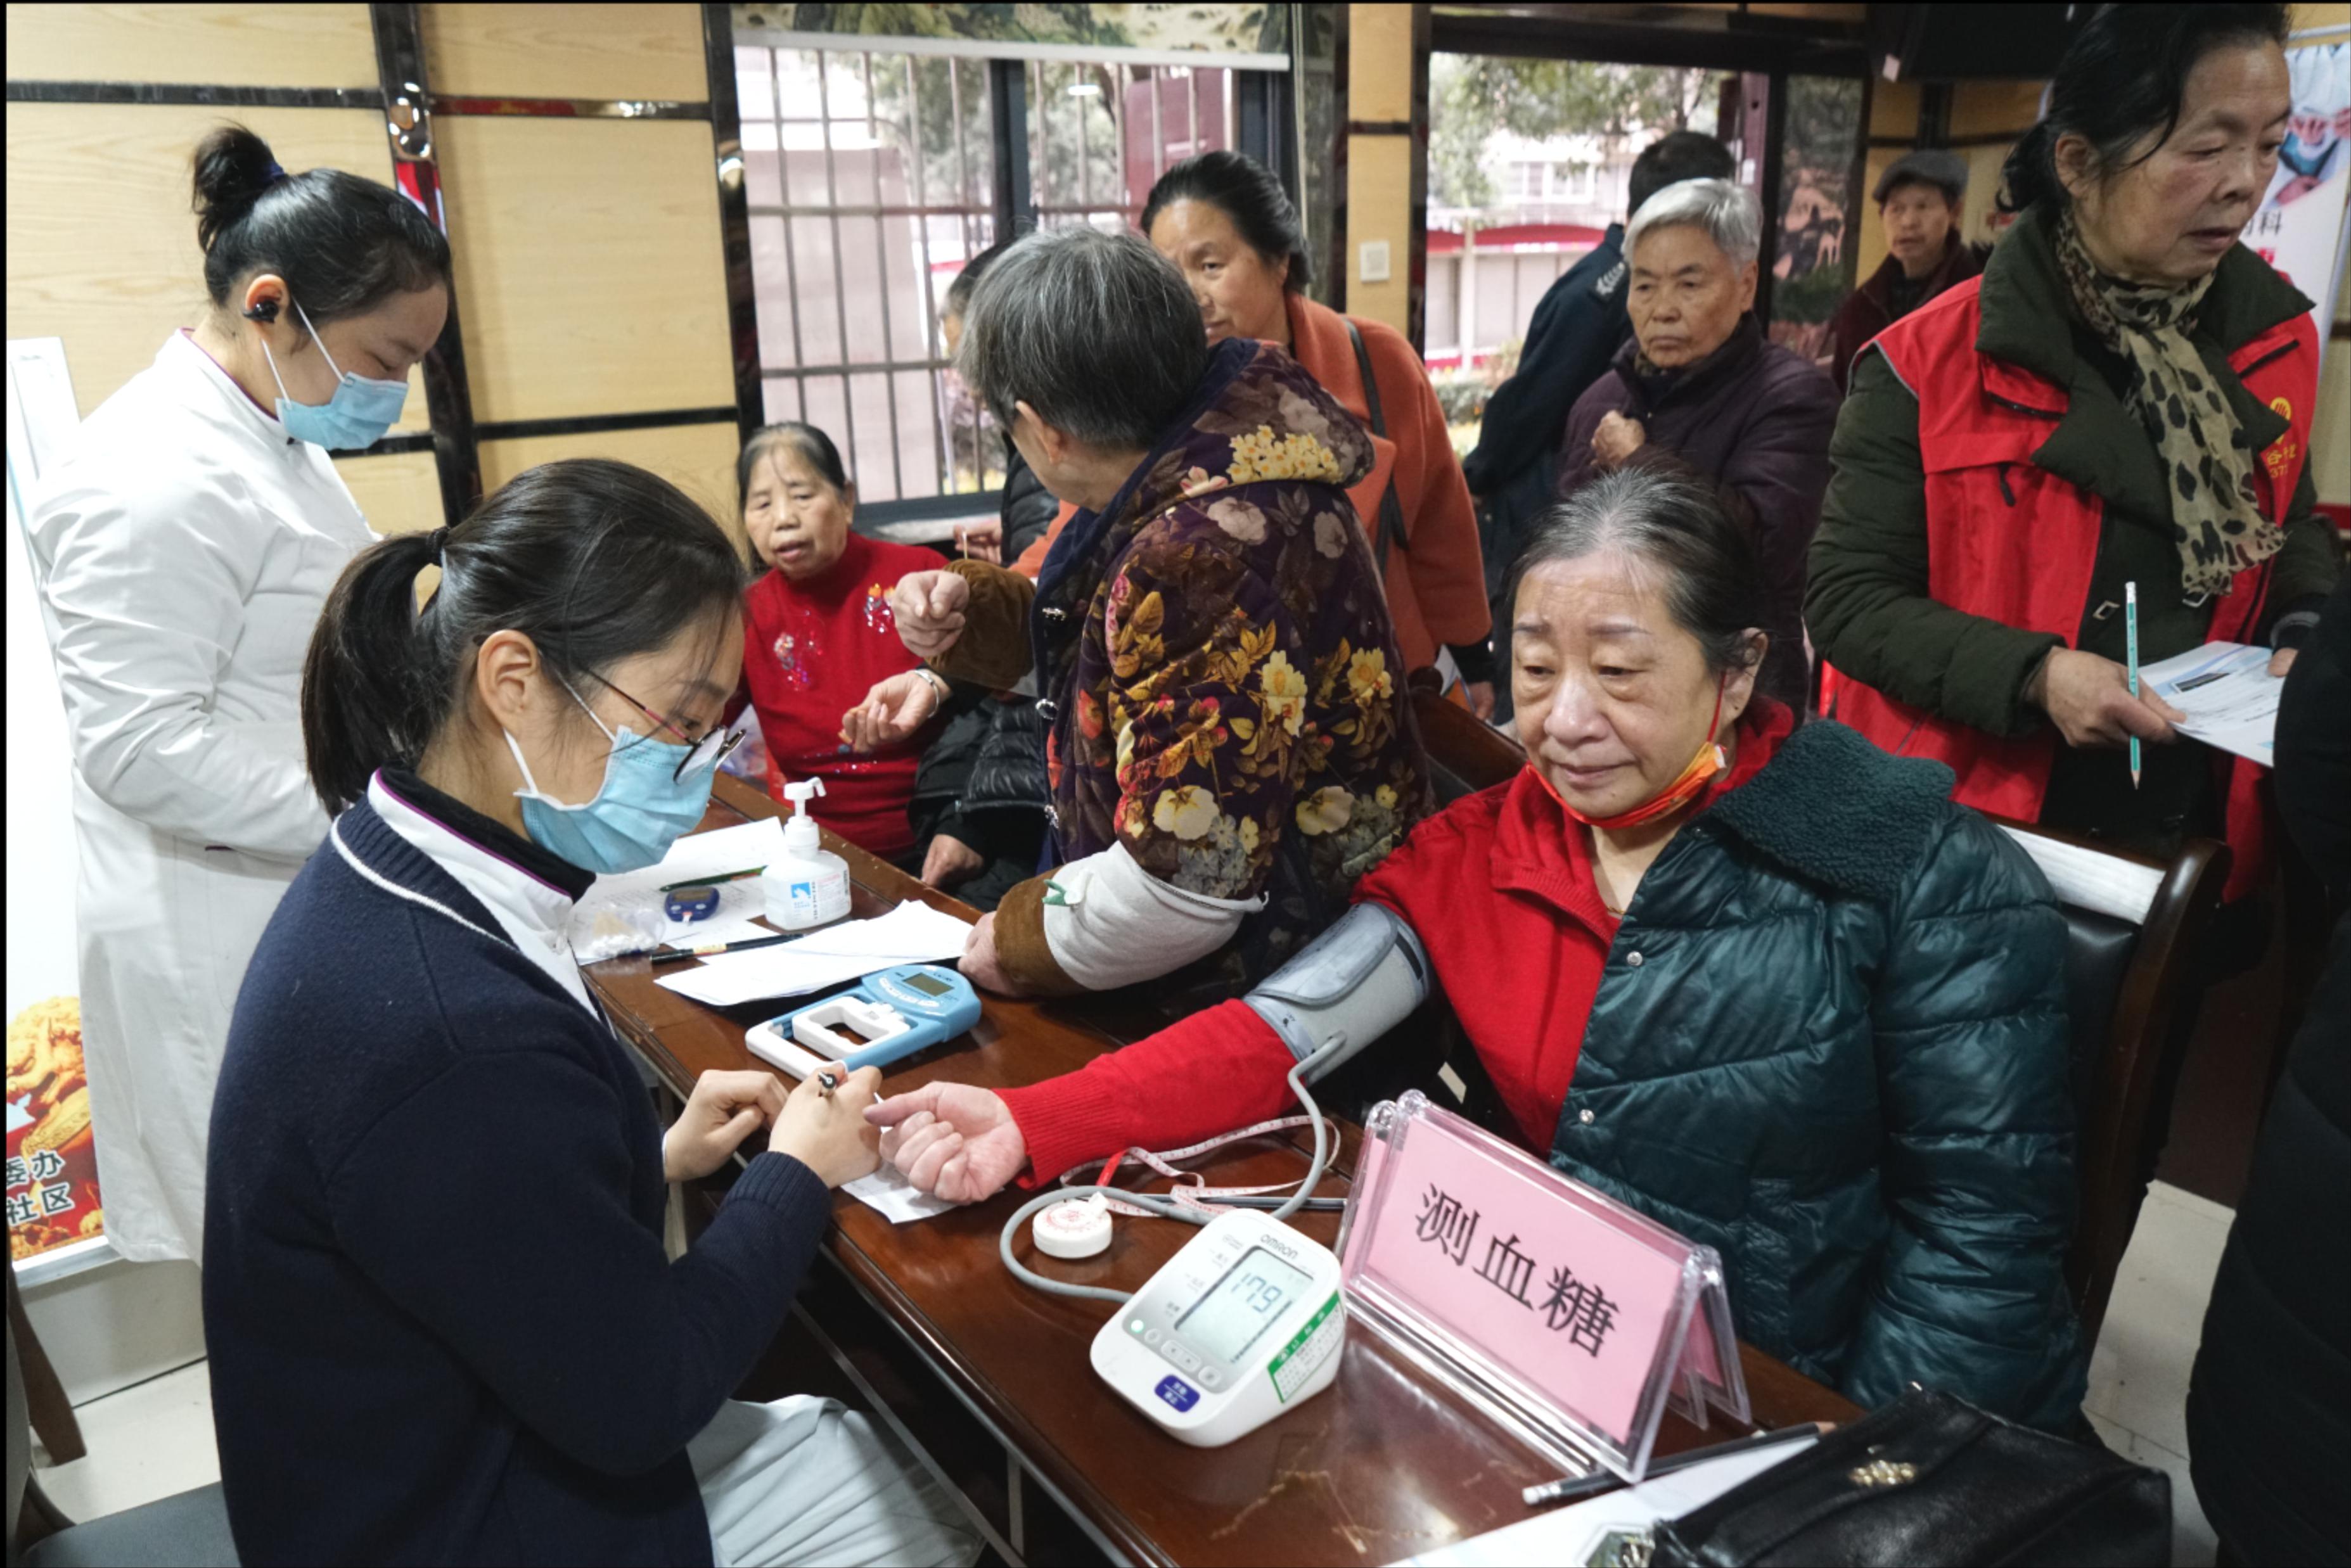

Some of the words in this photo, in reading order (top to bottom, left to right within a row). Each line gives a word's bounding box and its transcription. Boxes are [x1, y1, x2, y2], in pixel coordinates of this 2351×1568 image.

[6, 1184, 73, 1224] 社区
[1260, 1233, 1298, 1259] OMRON
[1415, 1182, 1620, 1358] 测血糖
[1231, 1272, 1283, 1313] 179
